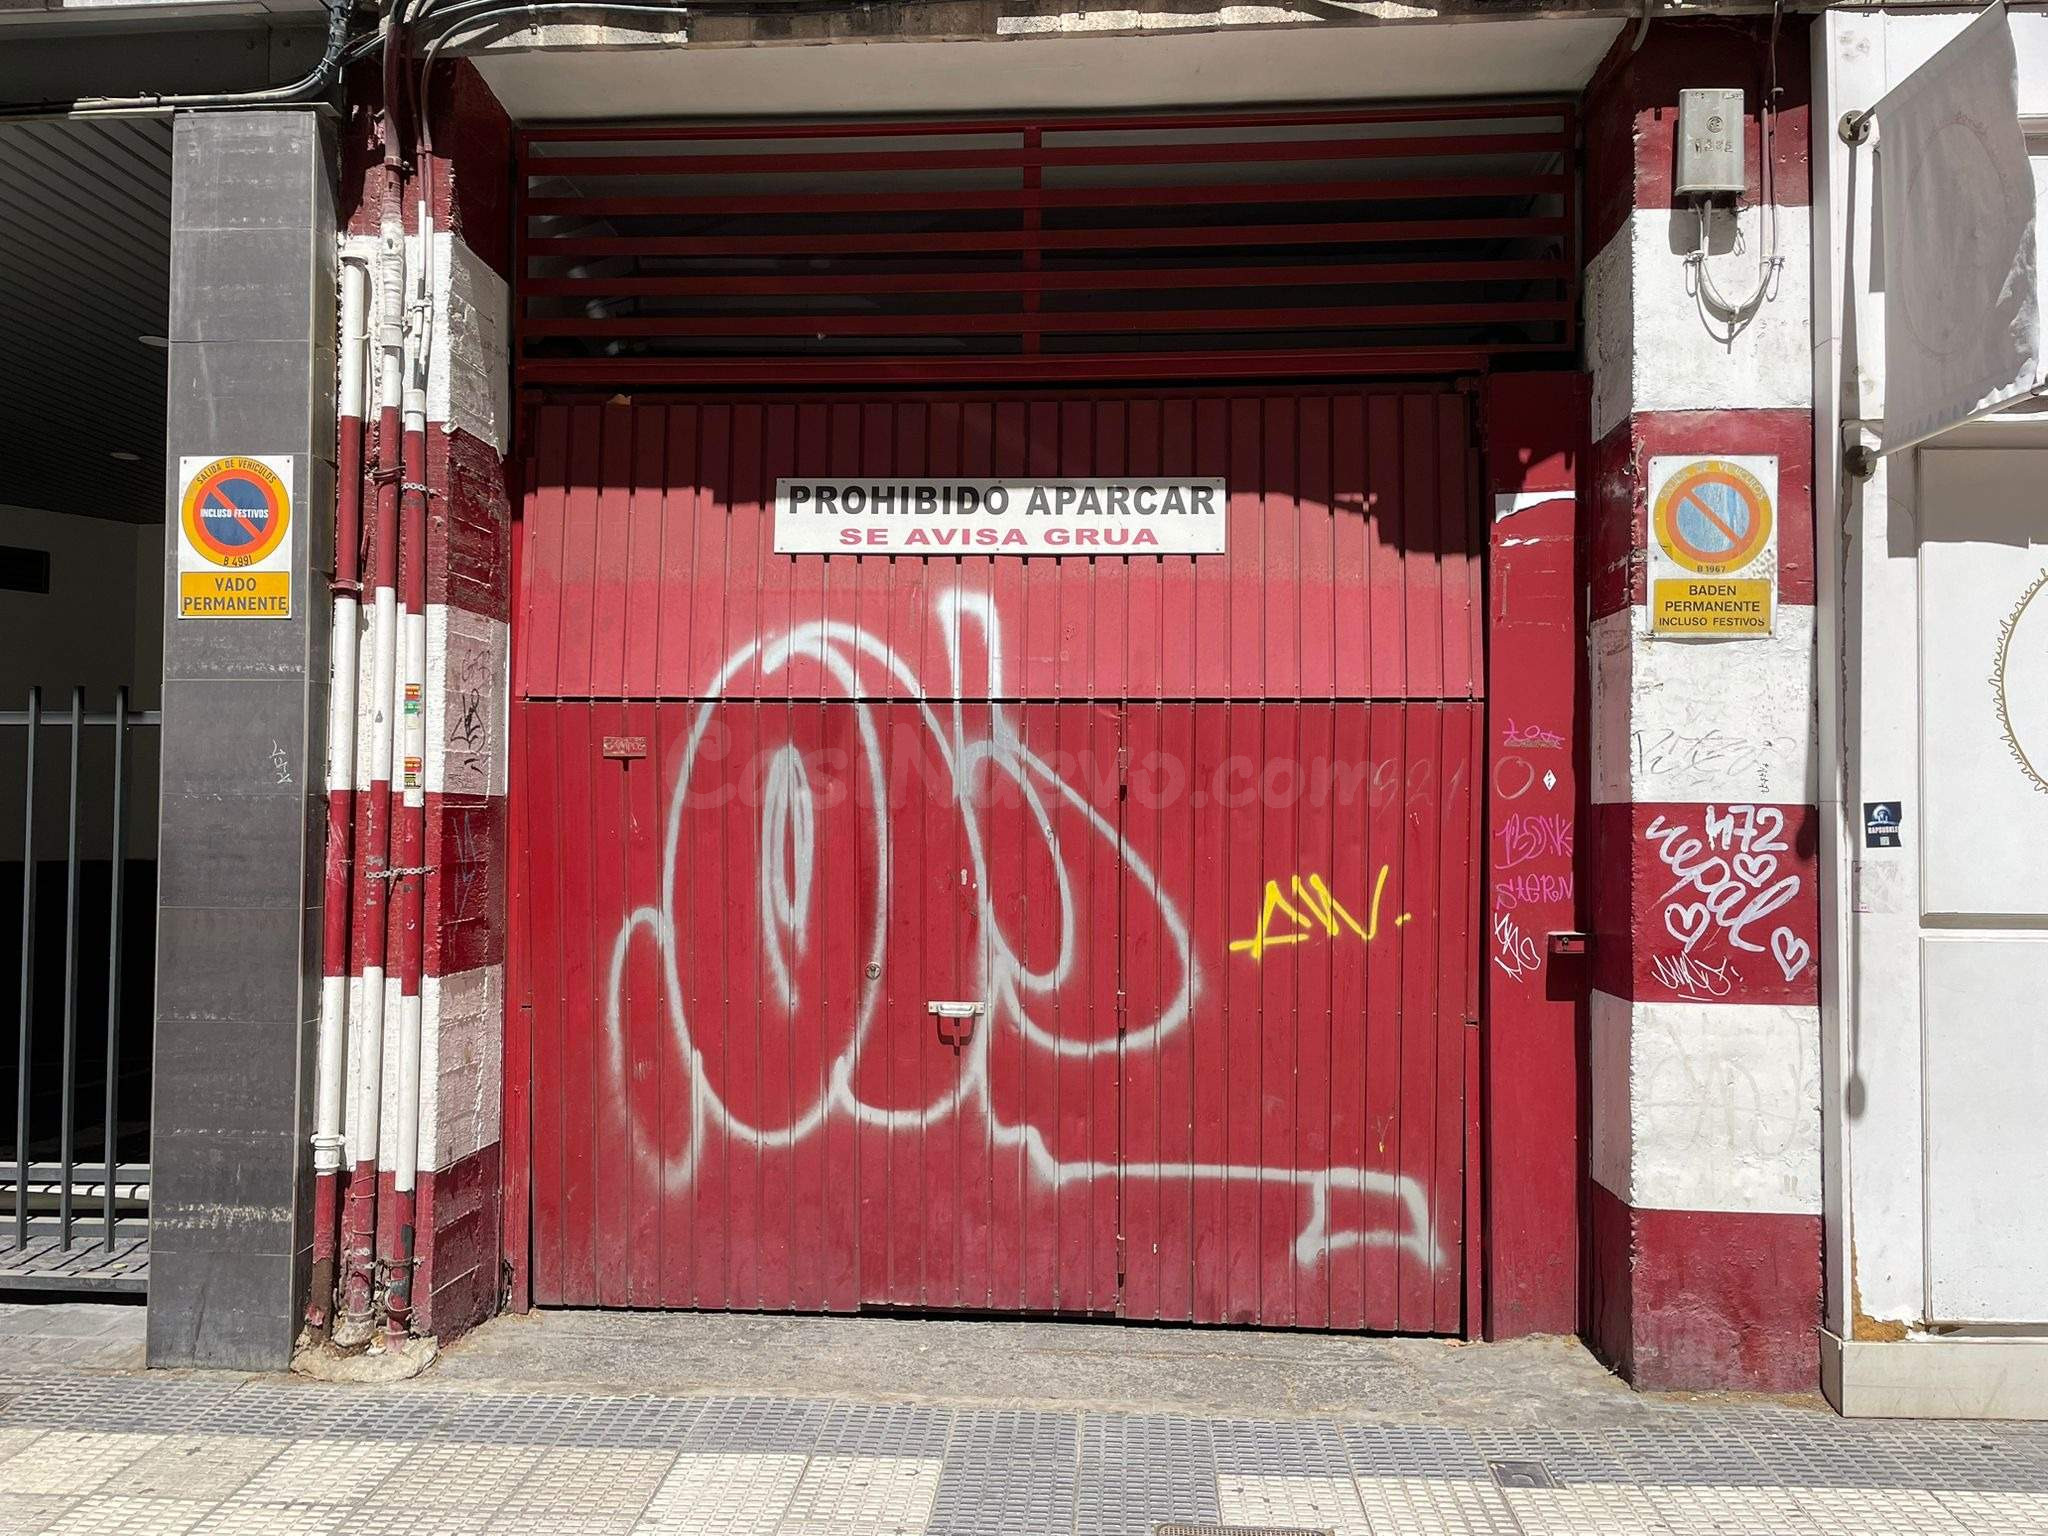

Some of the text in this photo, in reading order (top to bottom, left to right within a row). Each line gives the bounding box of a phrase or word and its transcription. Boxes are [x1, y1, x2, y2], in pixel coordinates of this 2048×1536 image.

[196, 463, 222, 484] SALIDA
[238, 460, 277, 484] VEHICULOS
[788, 485, 1216, 516] PROHIBIDO APARCAR
[200, 508, 269, 519] INCLUSO FESTIVOS
[839, 528, 1160, 545] SE AVISA GRUA
[1705, 565, 1726, 573] 1967
[215, 577, 257, 591] VADO
[1689, 585, 1737, 596] BADEN
[183, 596, 287, 611] PERMANENTE
[1665, 601, 1760, 612] PERMANENTE
[1659, 617, 1765, 627] INCLUSO FESTIVOS
